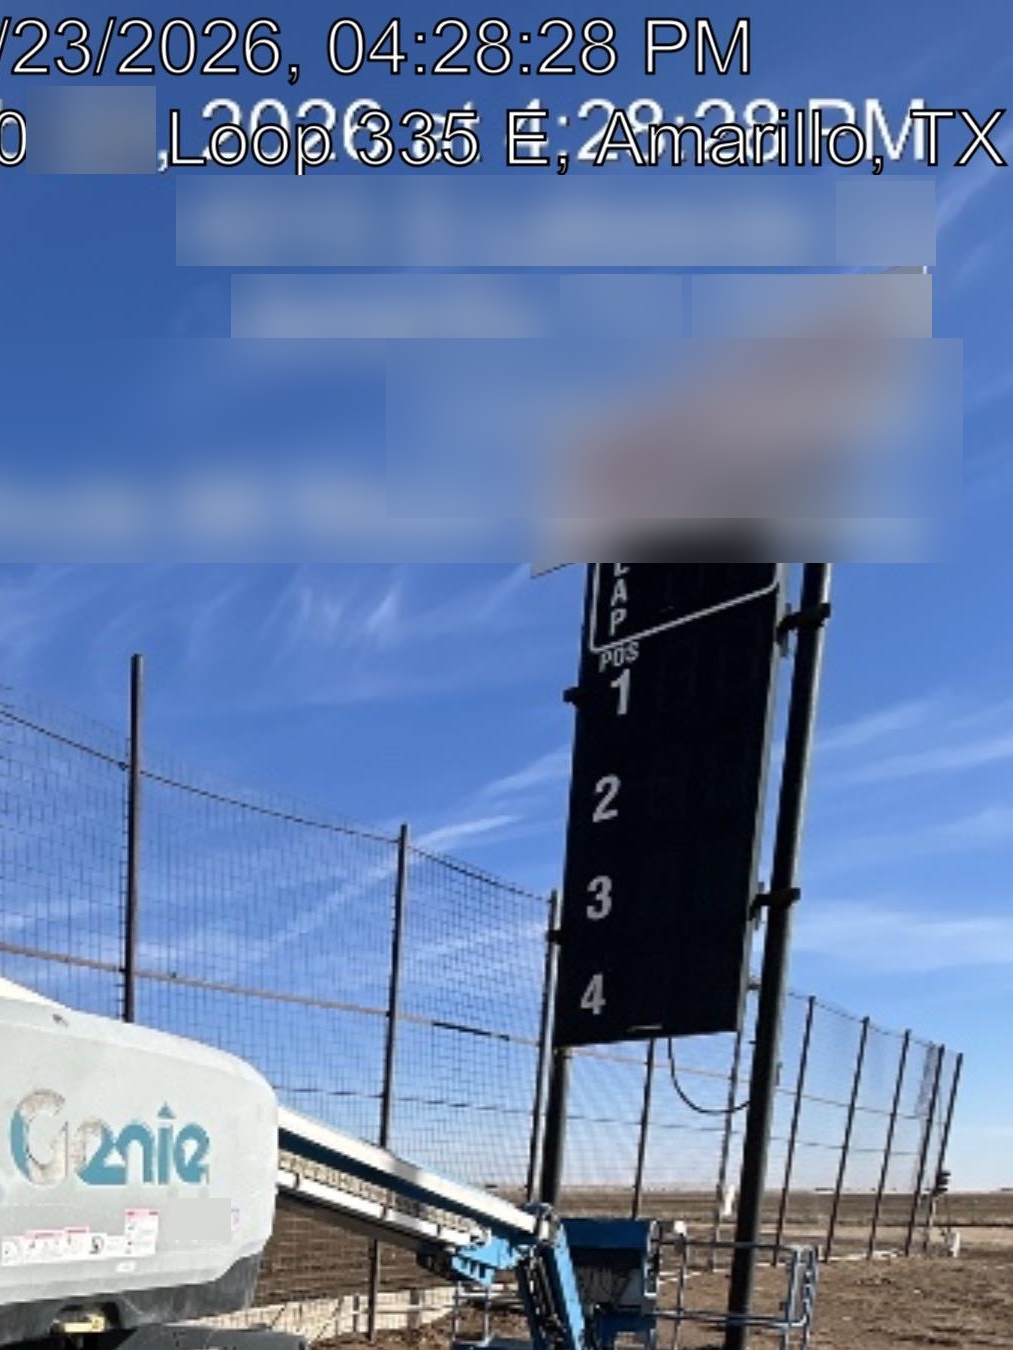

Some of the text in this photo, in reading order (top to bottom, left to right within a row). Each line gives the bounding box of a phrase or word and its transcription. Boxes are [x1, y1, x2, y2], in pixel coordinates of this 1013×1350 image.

[598, 641, 640, 673] POS
[610, 668, 631, 716] 1
[592, 775, 621, 823] 2
[586, 875, 613, 919] 3
[580, 974, 606, 1016] 4
[9, 1089, 211, 1188] Genie
